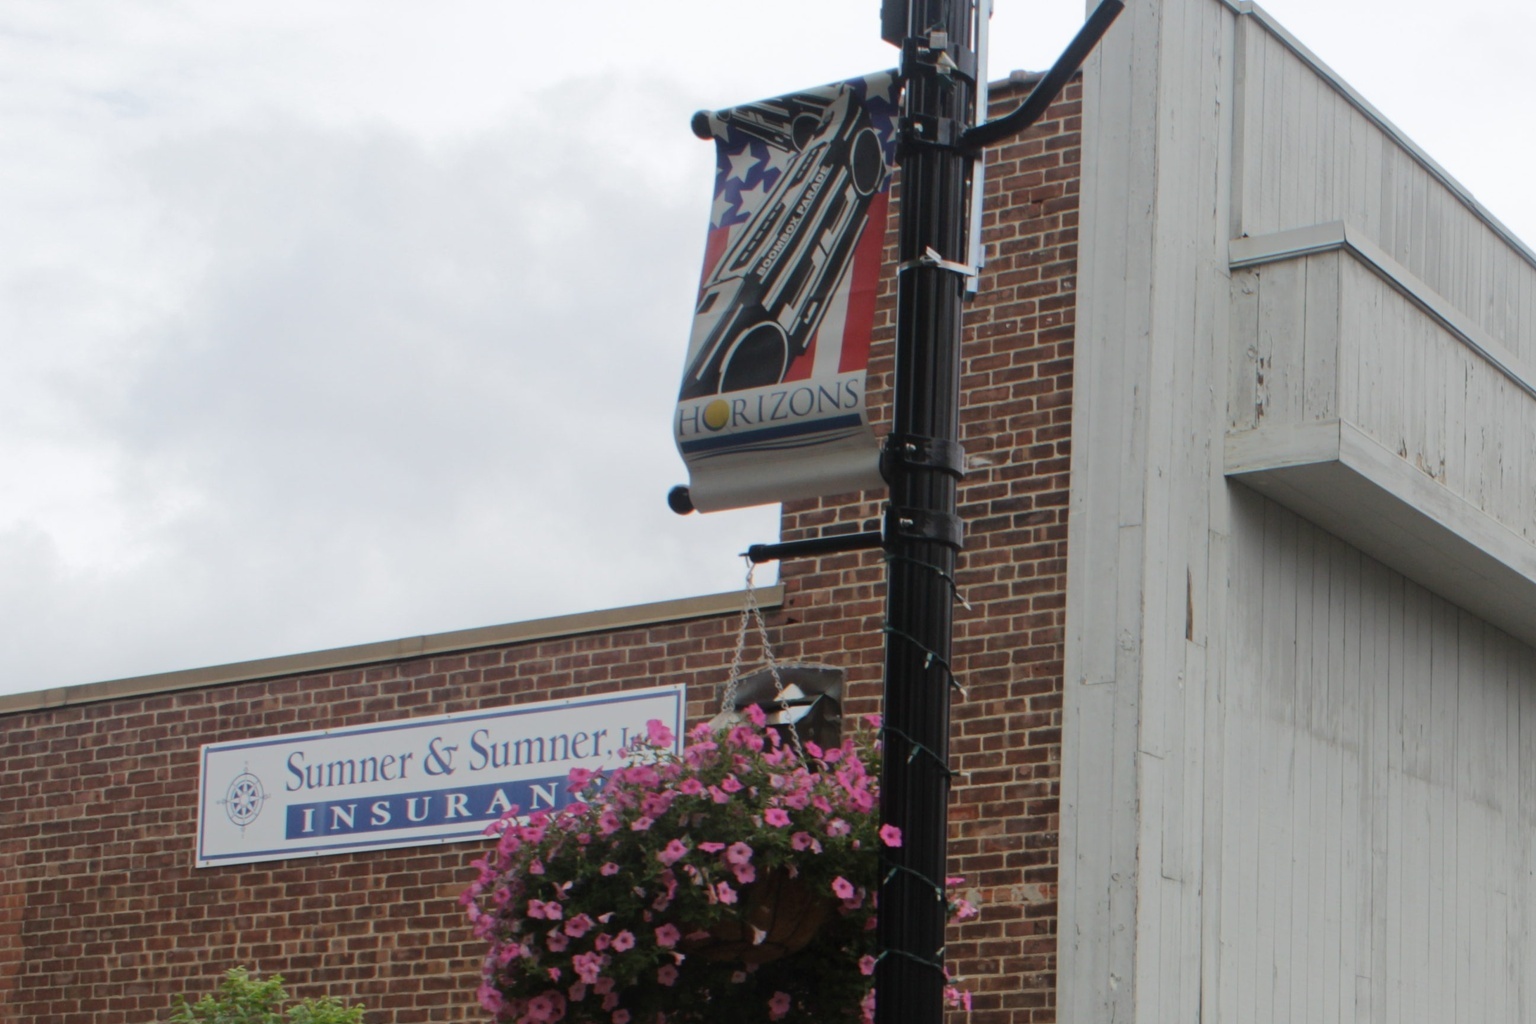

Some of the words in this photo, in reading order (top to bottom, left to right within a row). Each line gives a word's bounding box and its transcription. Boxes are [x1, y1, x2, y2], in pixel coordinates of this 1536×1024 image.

[756, 215, 800, 277] BOOMBOX
[796, 165, 833, 216] PARADE
[678, 378, 860, 436] HORIZONS
[284, 750, 413, 793] Sumner
[423, 736, 458, 777] &
[469, 727, 614, 771] Sumner,
